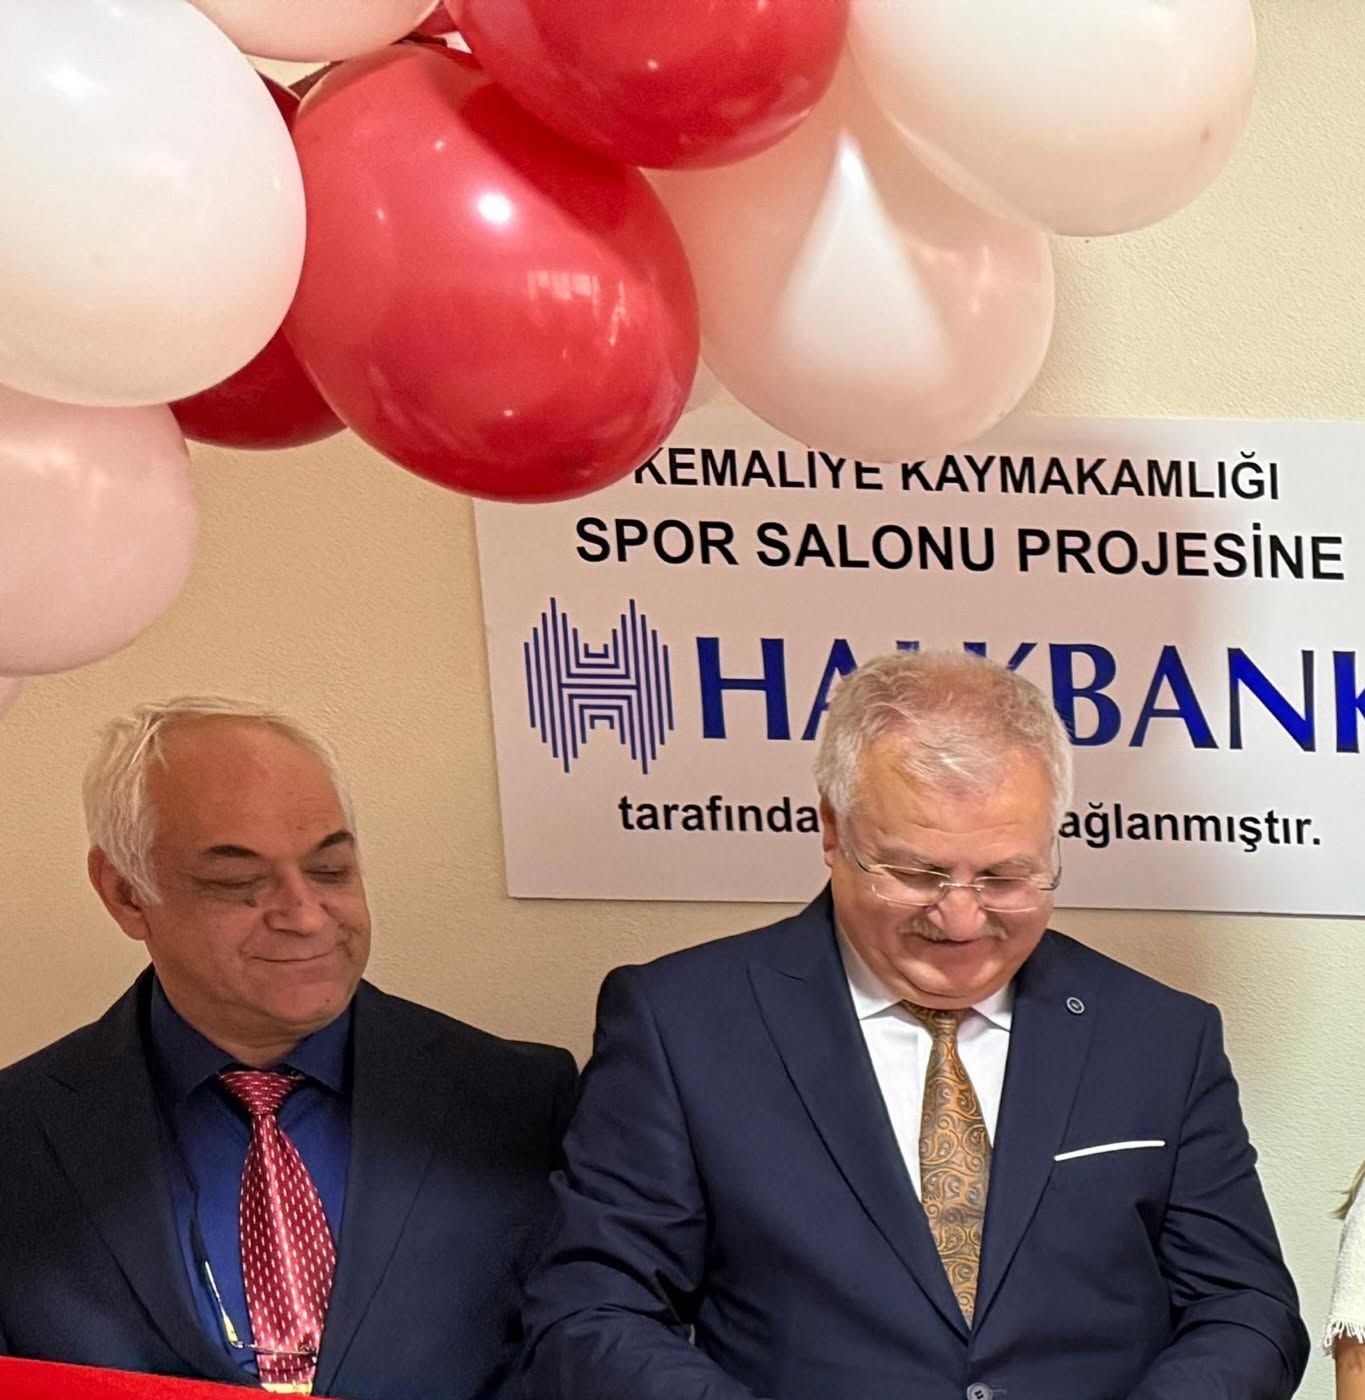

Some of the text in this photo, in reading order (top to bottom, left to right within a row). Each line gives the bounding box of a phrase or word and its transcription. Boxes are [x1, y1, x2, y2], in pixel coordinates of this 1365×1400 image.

[901, 452, 1279, 500] KAYMAKAMLIĞI
[576, 517, 1344, 580] SPOR SALONU PROJESİNE
[618, 795, 1321, 853] tarafında ağlanmıştır.
